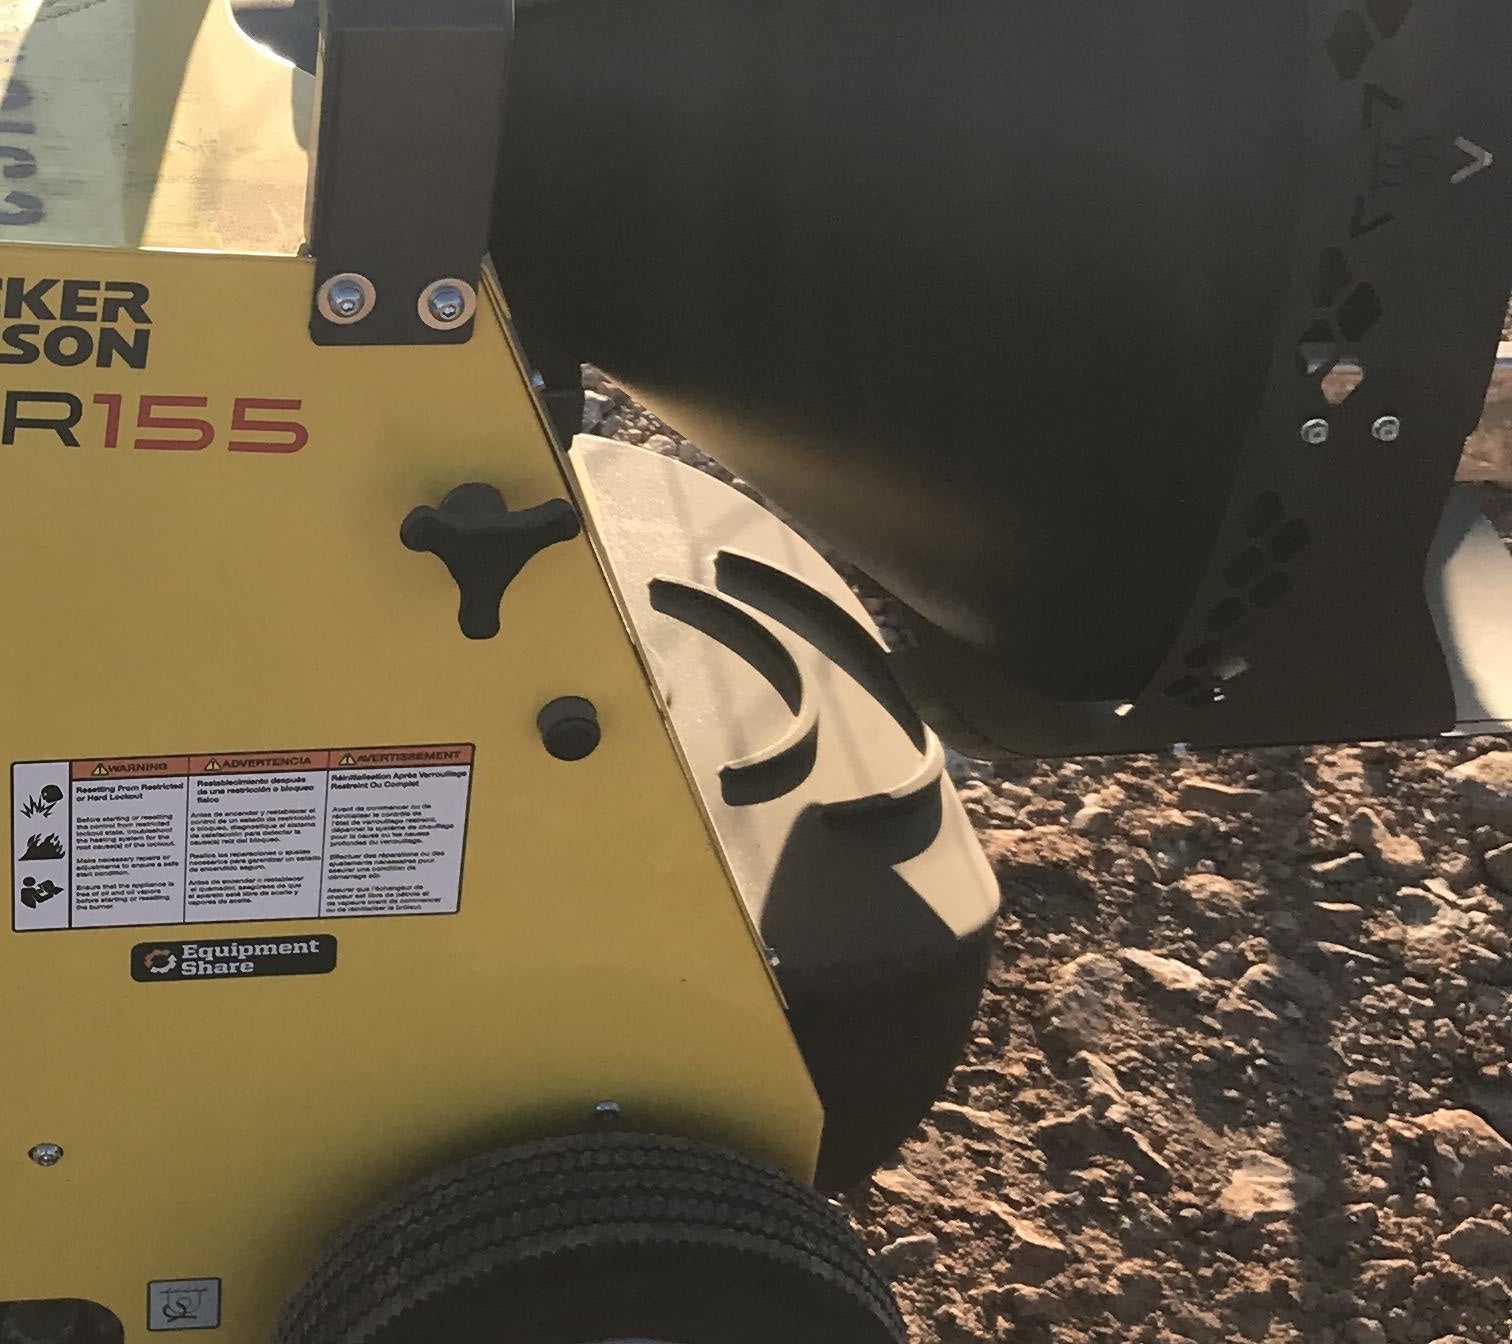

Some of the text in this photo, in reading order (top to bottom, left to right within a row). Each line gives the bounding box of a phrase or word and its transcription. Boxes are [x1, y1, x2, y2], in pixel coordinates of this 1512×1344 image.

[222, 756, 311, 768] ADVERTENCIA
[357, 750, 461, 763] AVERTISSEMENT
[108, 762, 168, 772] WARNING
[181, 939, 320, 960] Equipment
[181, 960, 254, 976] Share
